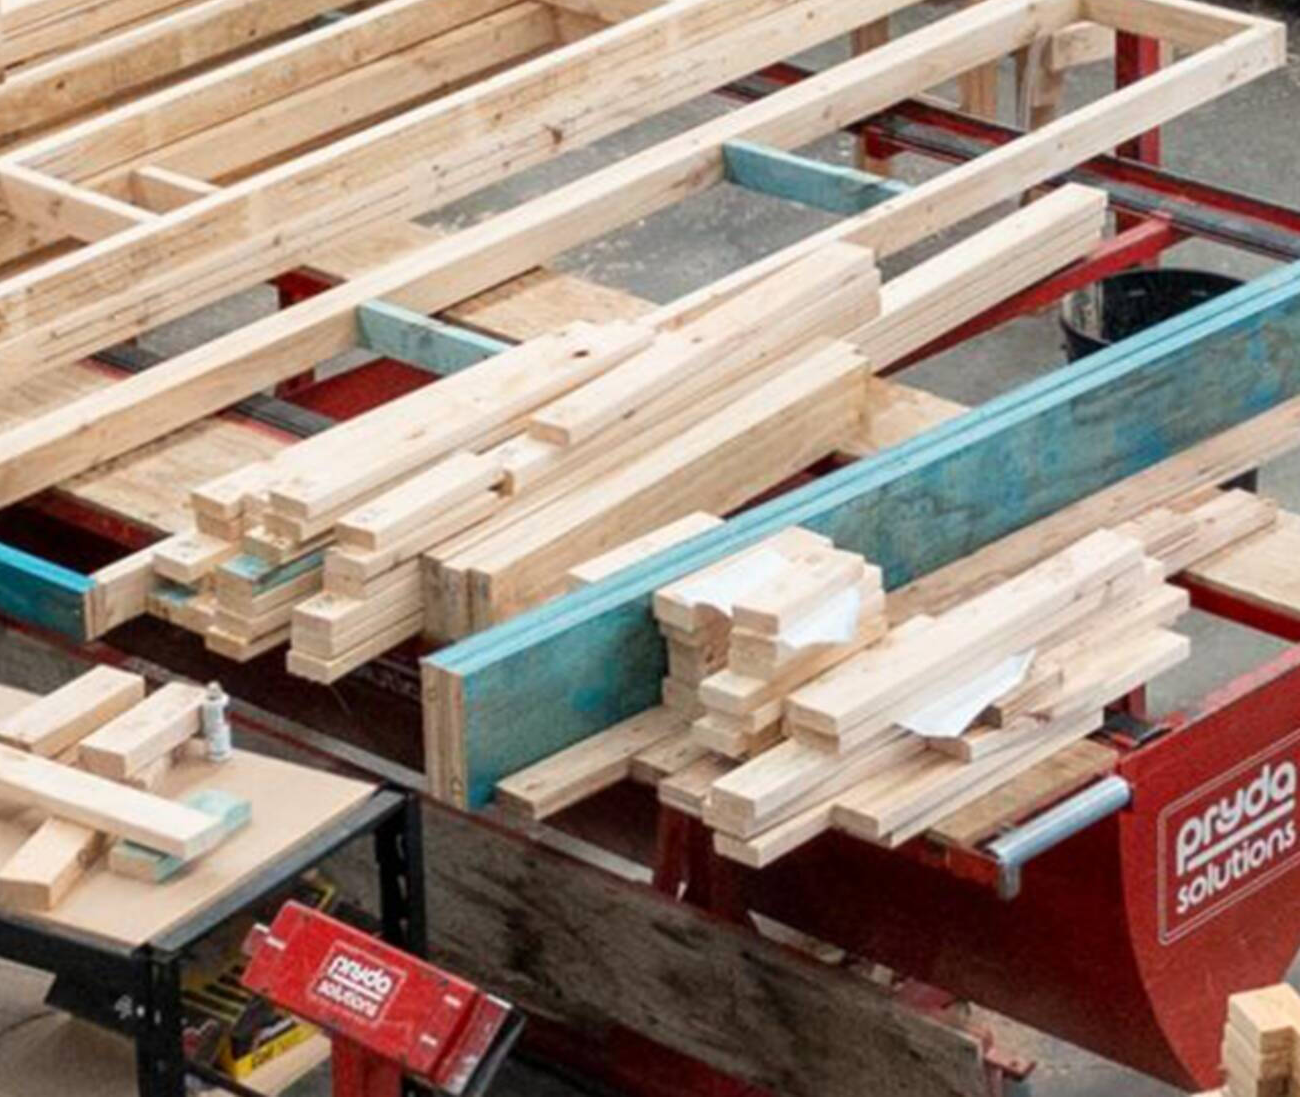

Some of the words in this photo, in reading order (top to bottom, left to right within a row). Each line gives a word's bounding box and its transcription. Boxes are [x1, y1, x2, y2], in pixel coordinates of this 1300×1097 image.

[1176, 761, 1297, 877] pryda
[1175, 820, 1297, 914] solutions
[316, 980, 379, 1018] solutions
[327, 954, 392, 996] pryda
